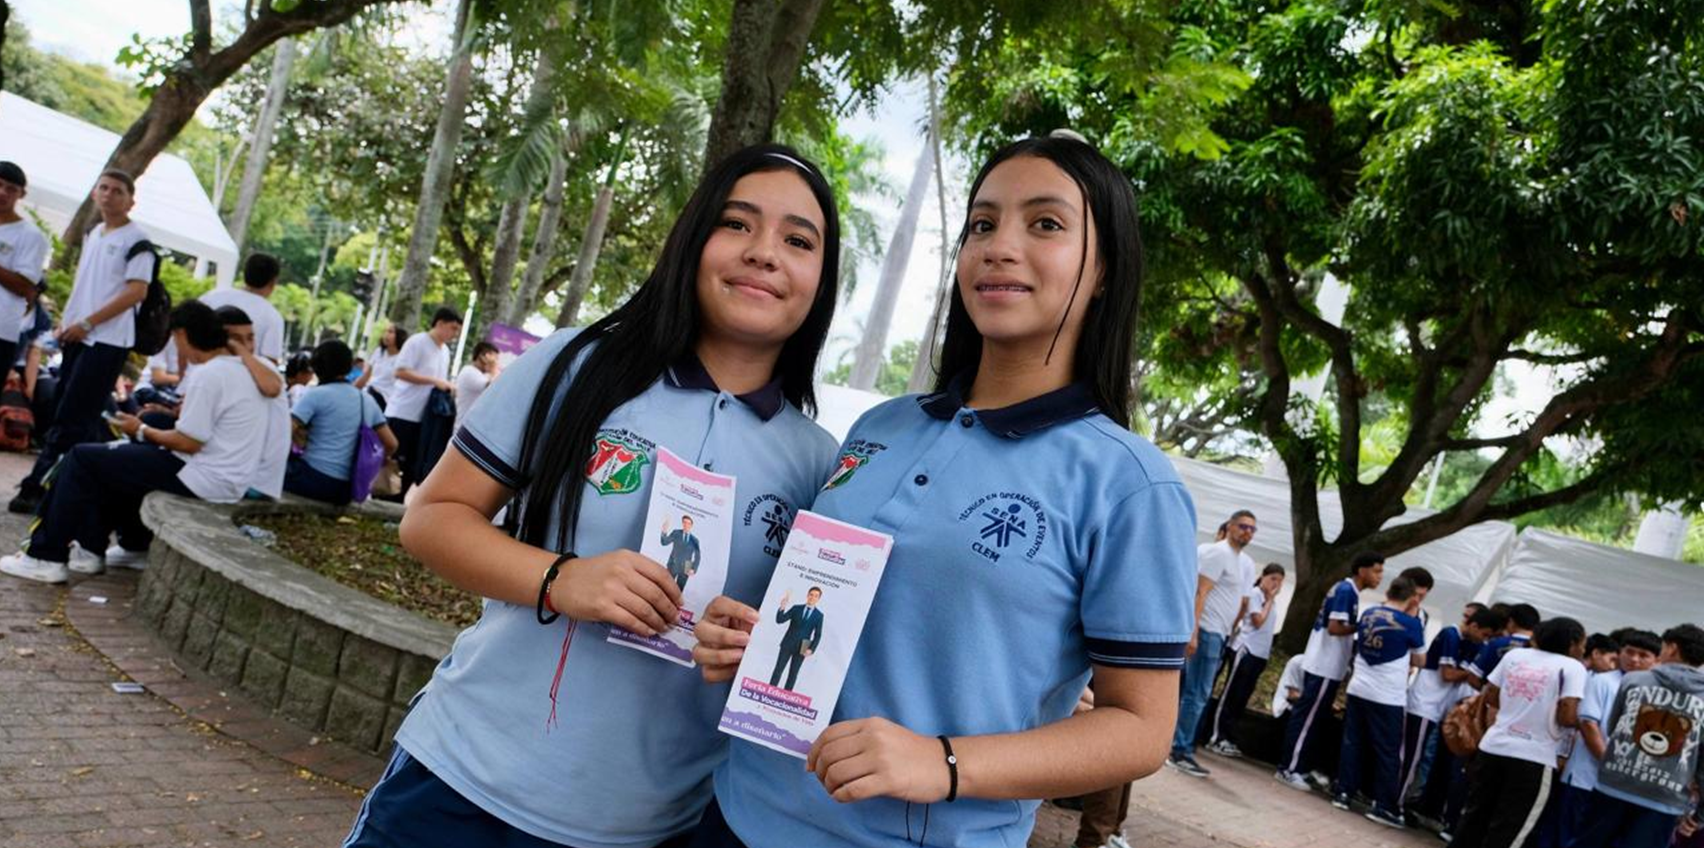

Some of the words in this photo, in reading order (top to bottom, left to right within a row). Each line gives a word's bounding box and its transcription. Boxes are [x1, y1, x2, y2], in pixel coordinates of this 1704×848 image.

[985, 492, 998, 502] EN
[999, 491, 1040, 513] OPERACIÓN
[991, 506, 1027, 531] SENA
[1036, 511, 1047, 524] DE
[971, 541, 1001, 563] CLEM
[1026, 525, 1047, 560] EVENTOS
[743, 678, 766, 693] Feria
[767, 687, 809, 706] Educativa
[740, 689, 752, 698] De
[752, 691, 760, 701] la
[761, 695, 817, 719] Vocacionalidad
